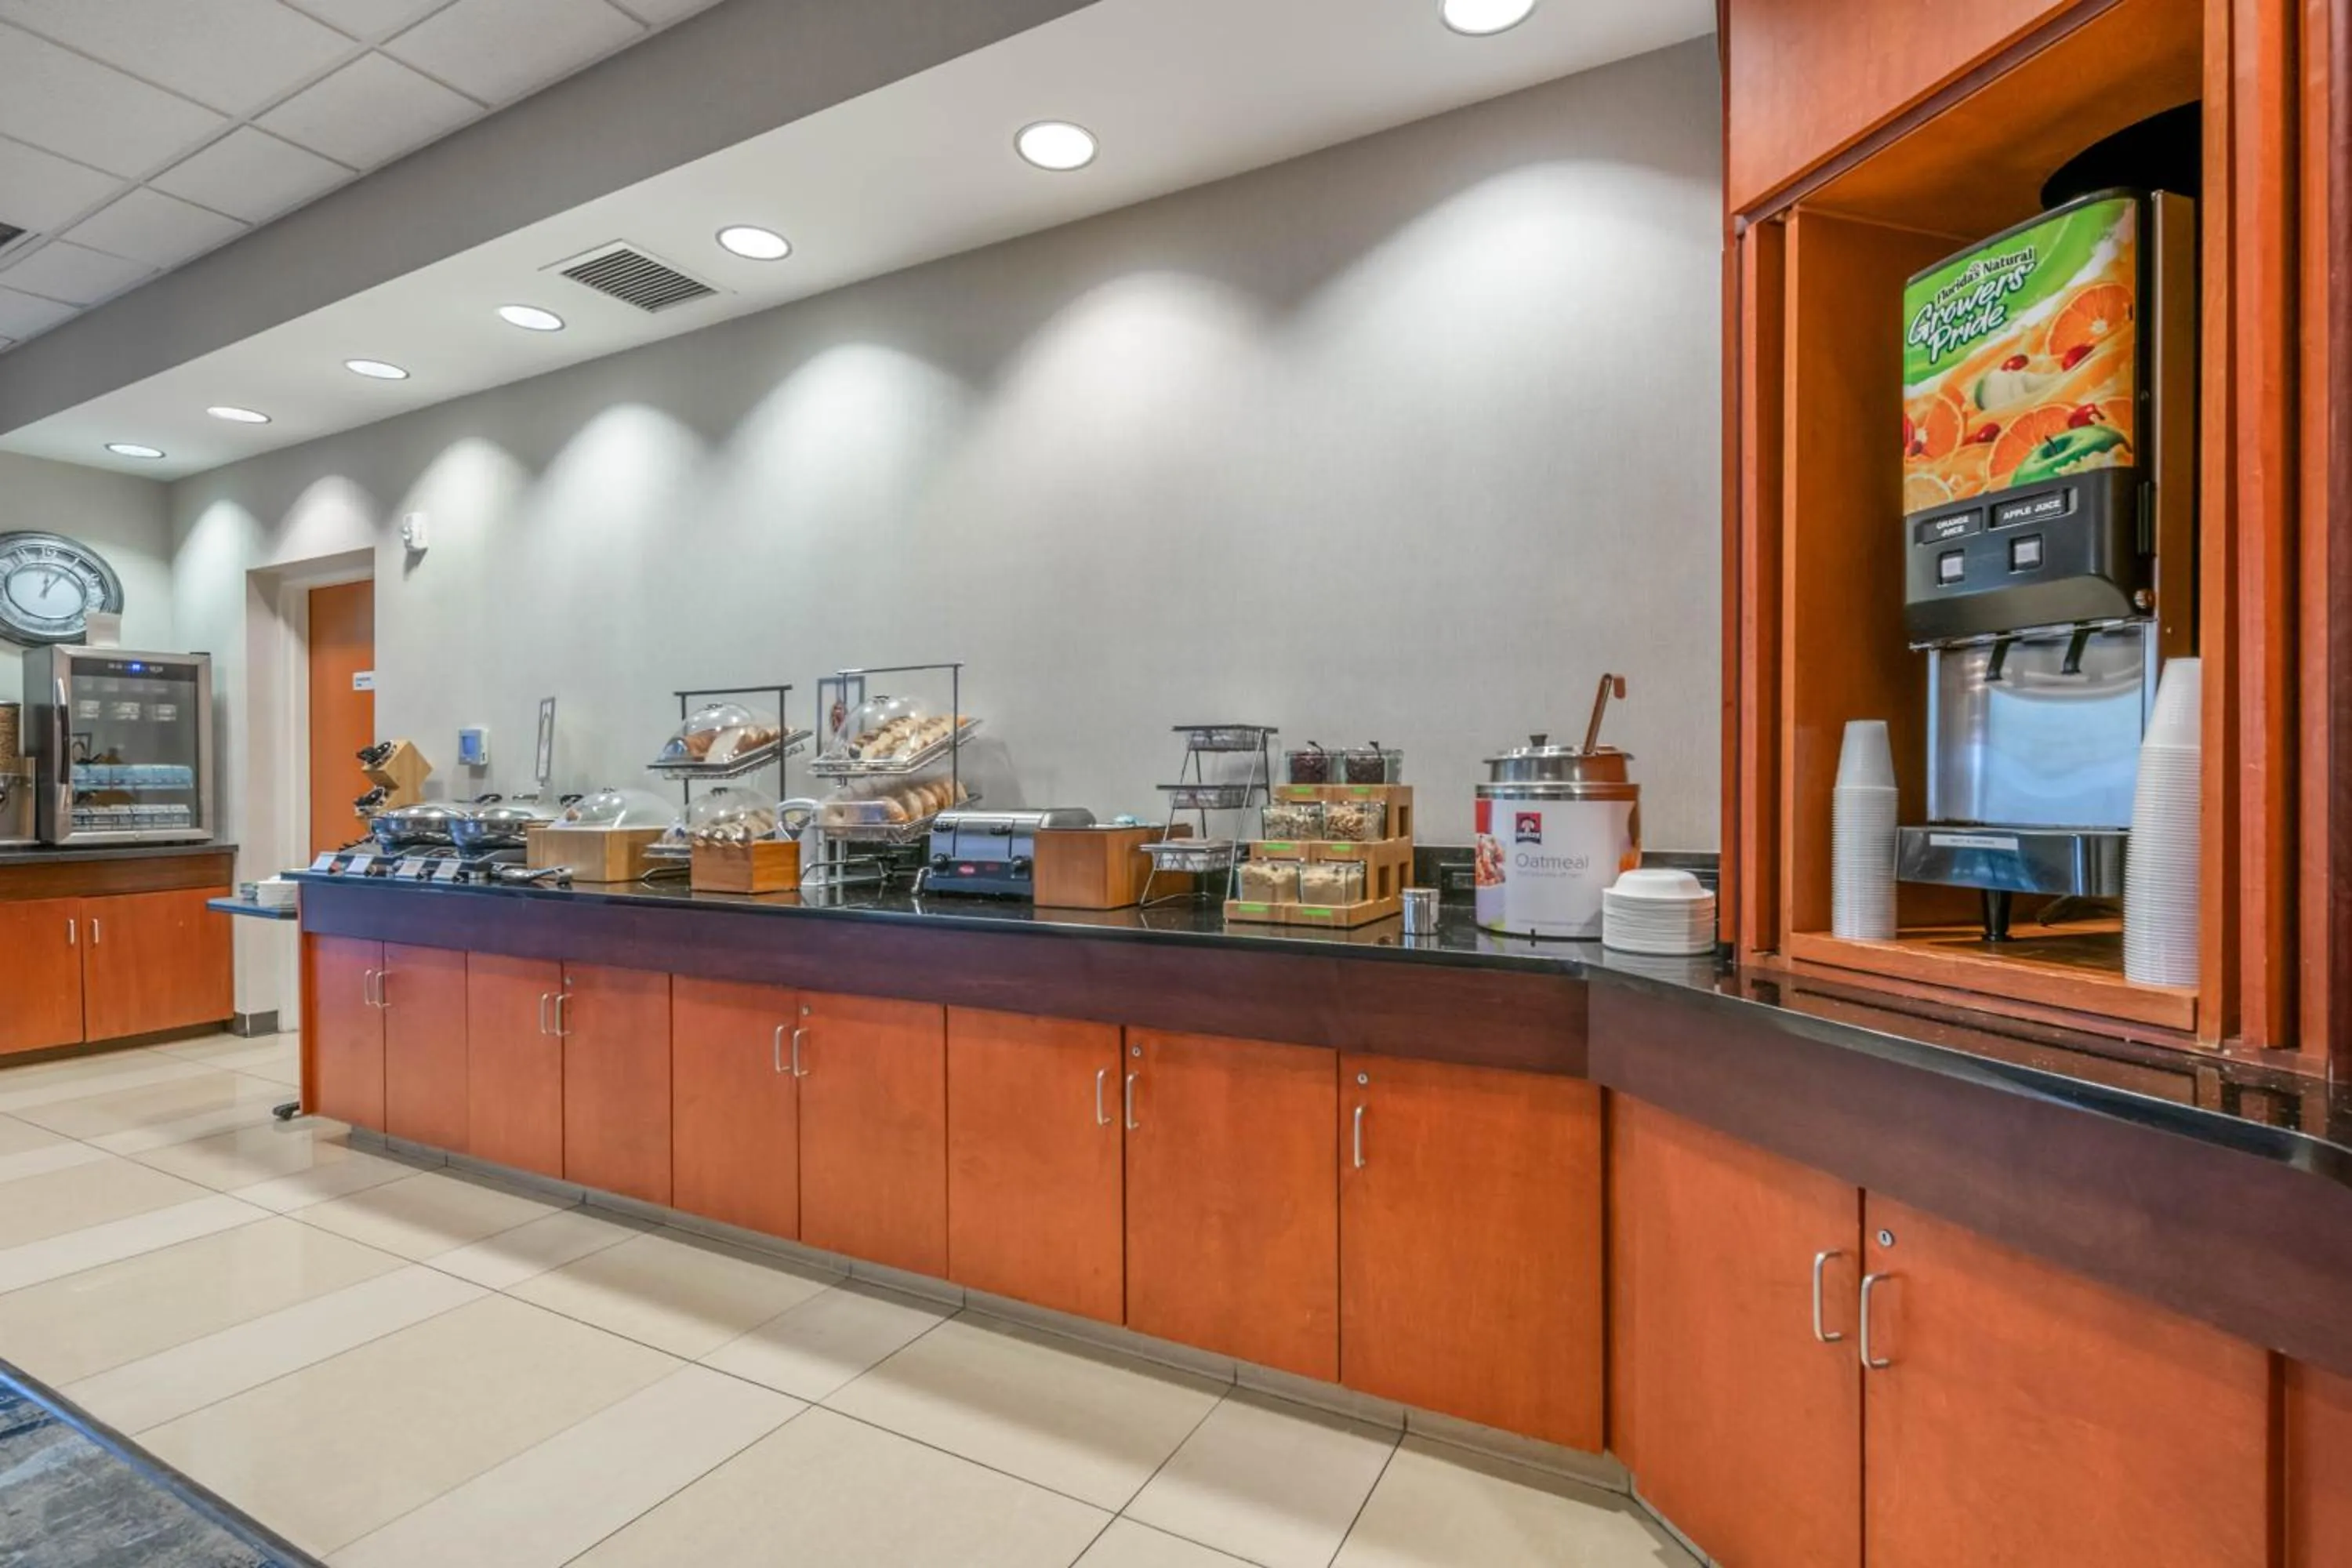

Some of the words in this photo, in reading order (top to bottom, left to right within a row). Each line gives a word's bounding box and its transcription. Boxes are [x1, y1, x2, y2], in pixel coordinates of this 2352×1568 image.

[1983, 249, 2033, 272] Natural
[1927, 301, 2005, 361] Pride
[2003, 506, 2031, 519] APPLE
[2034, 499, 2060, 512] JUICE
[1515, 853, 1589, 869] Oatmeal
